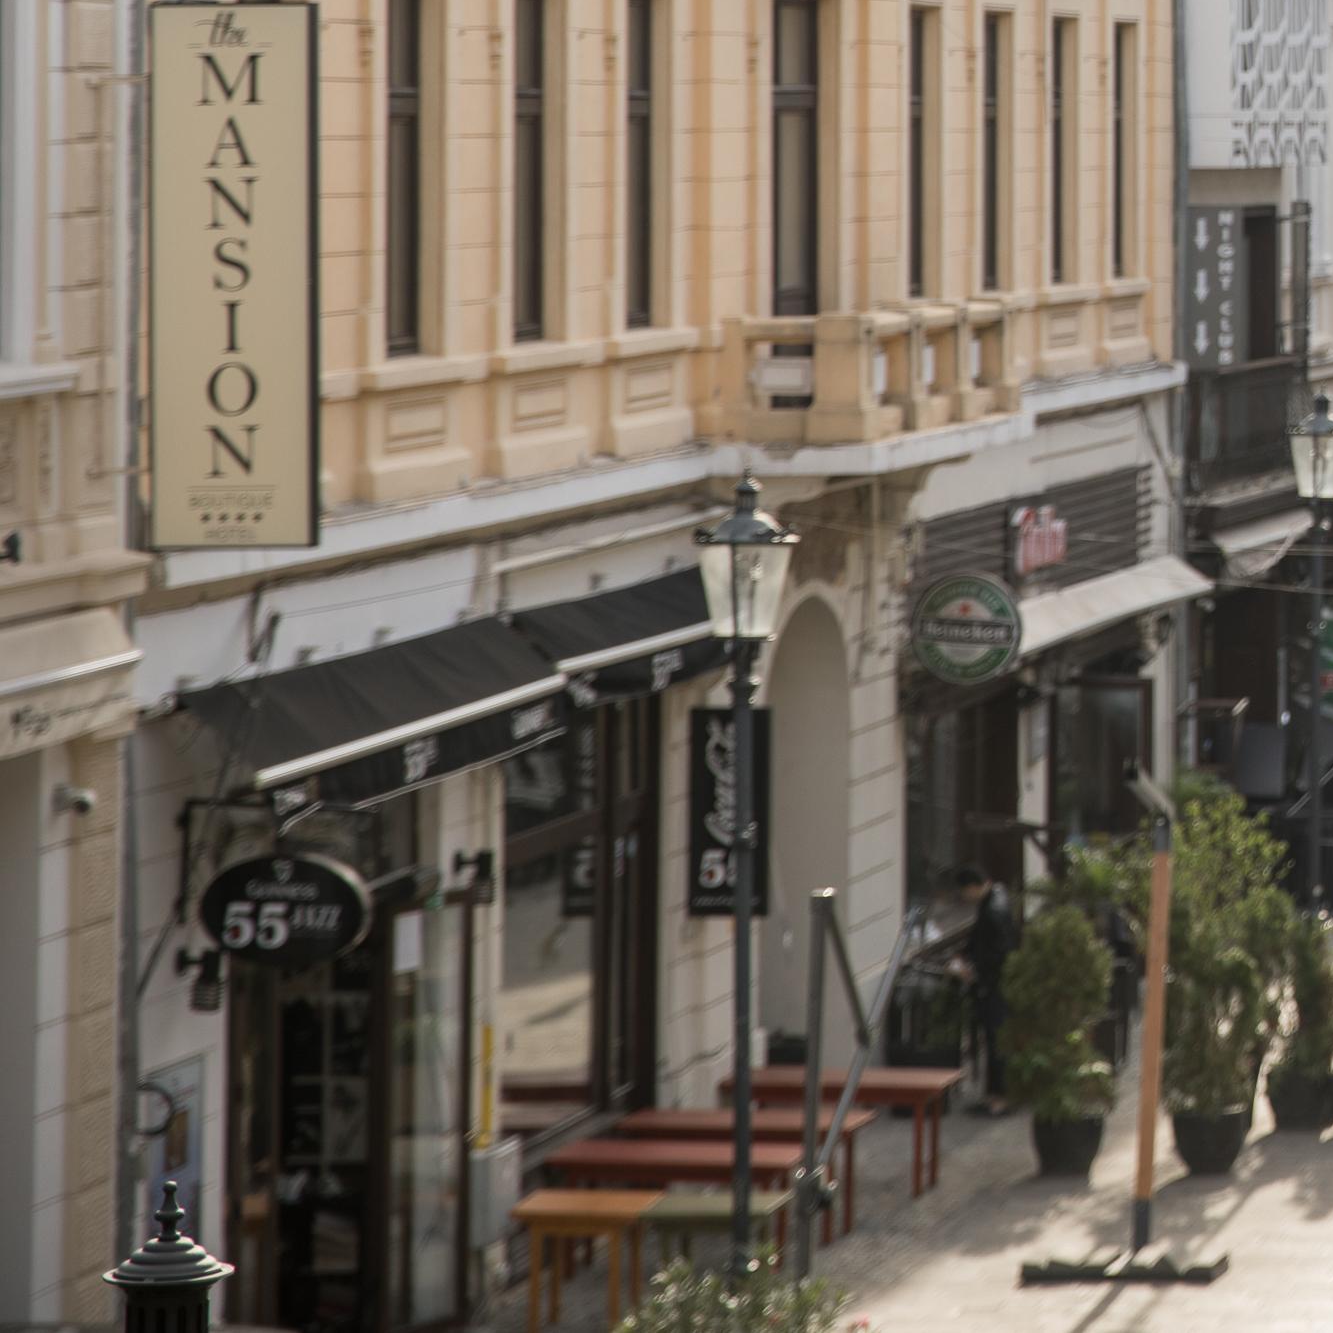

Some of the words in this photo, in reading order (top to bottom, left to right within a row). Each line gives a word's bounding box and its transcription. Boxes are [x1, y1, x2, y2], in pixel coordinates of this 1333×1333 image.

[194, 10, 249, 48] the
[195, 52, 266, 479] MANSION
[1216, 210, 1236, 291] NIGHT
[187, 493, 275, 510] BOUTIQUE
[222, 900, 291, 950] 55
